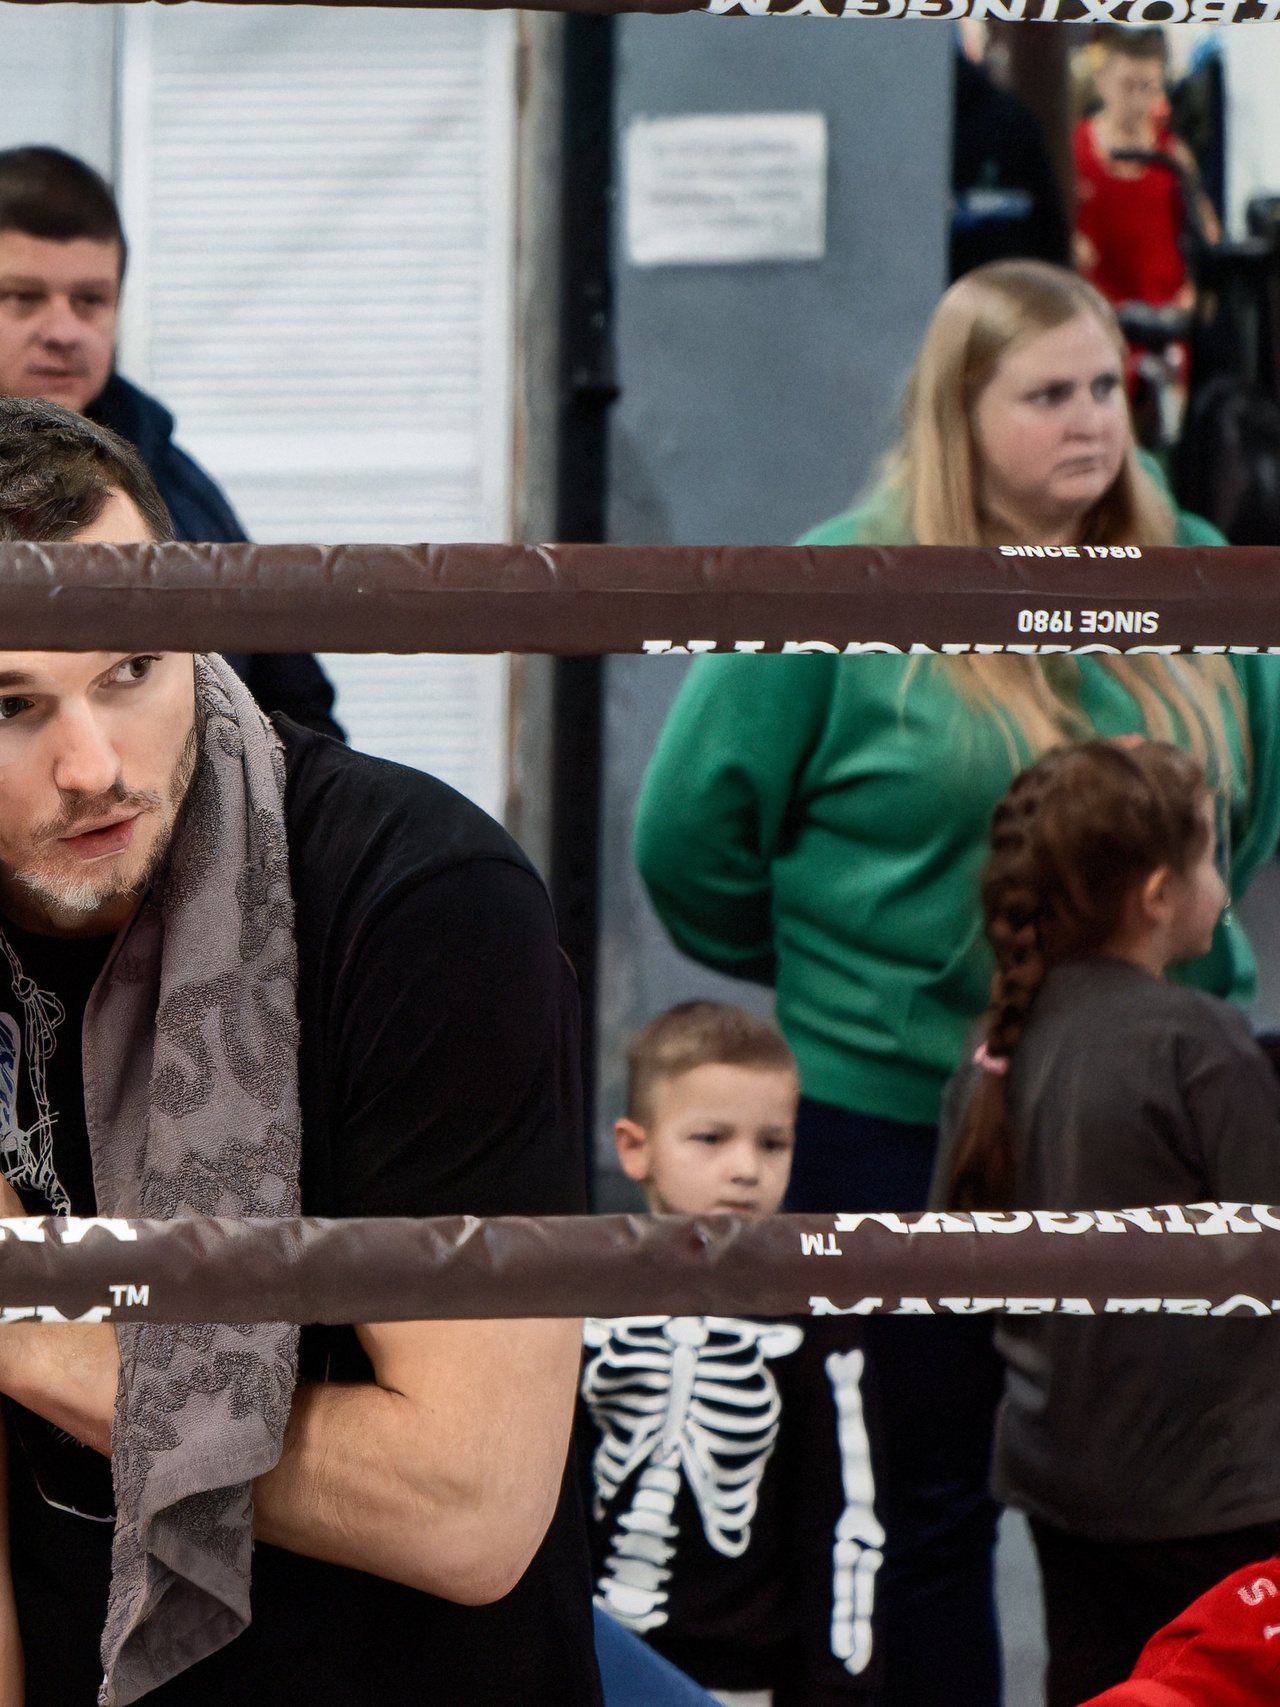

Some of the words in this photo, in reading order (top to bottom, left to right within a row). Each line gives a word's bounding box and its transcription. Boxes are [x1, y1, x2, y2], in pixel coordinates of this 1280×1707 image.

[998, 545, 1081, 559] SINCE
[1082, 545, 1143, 559] 1980
[1017, 609, 1074, 634] 1980
[1079, 609, 1159, 634] SINCE
